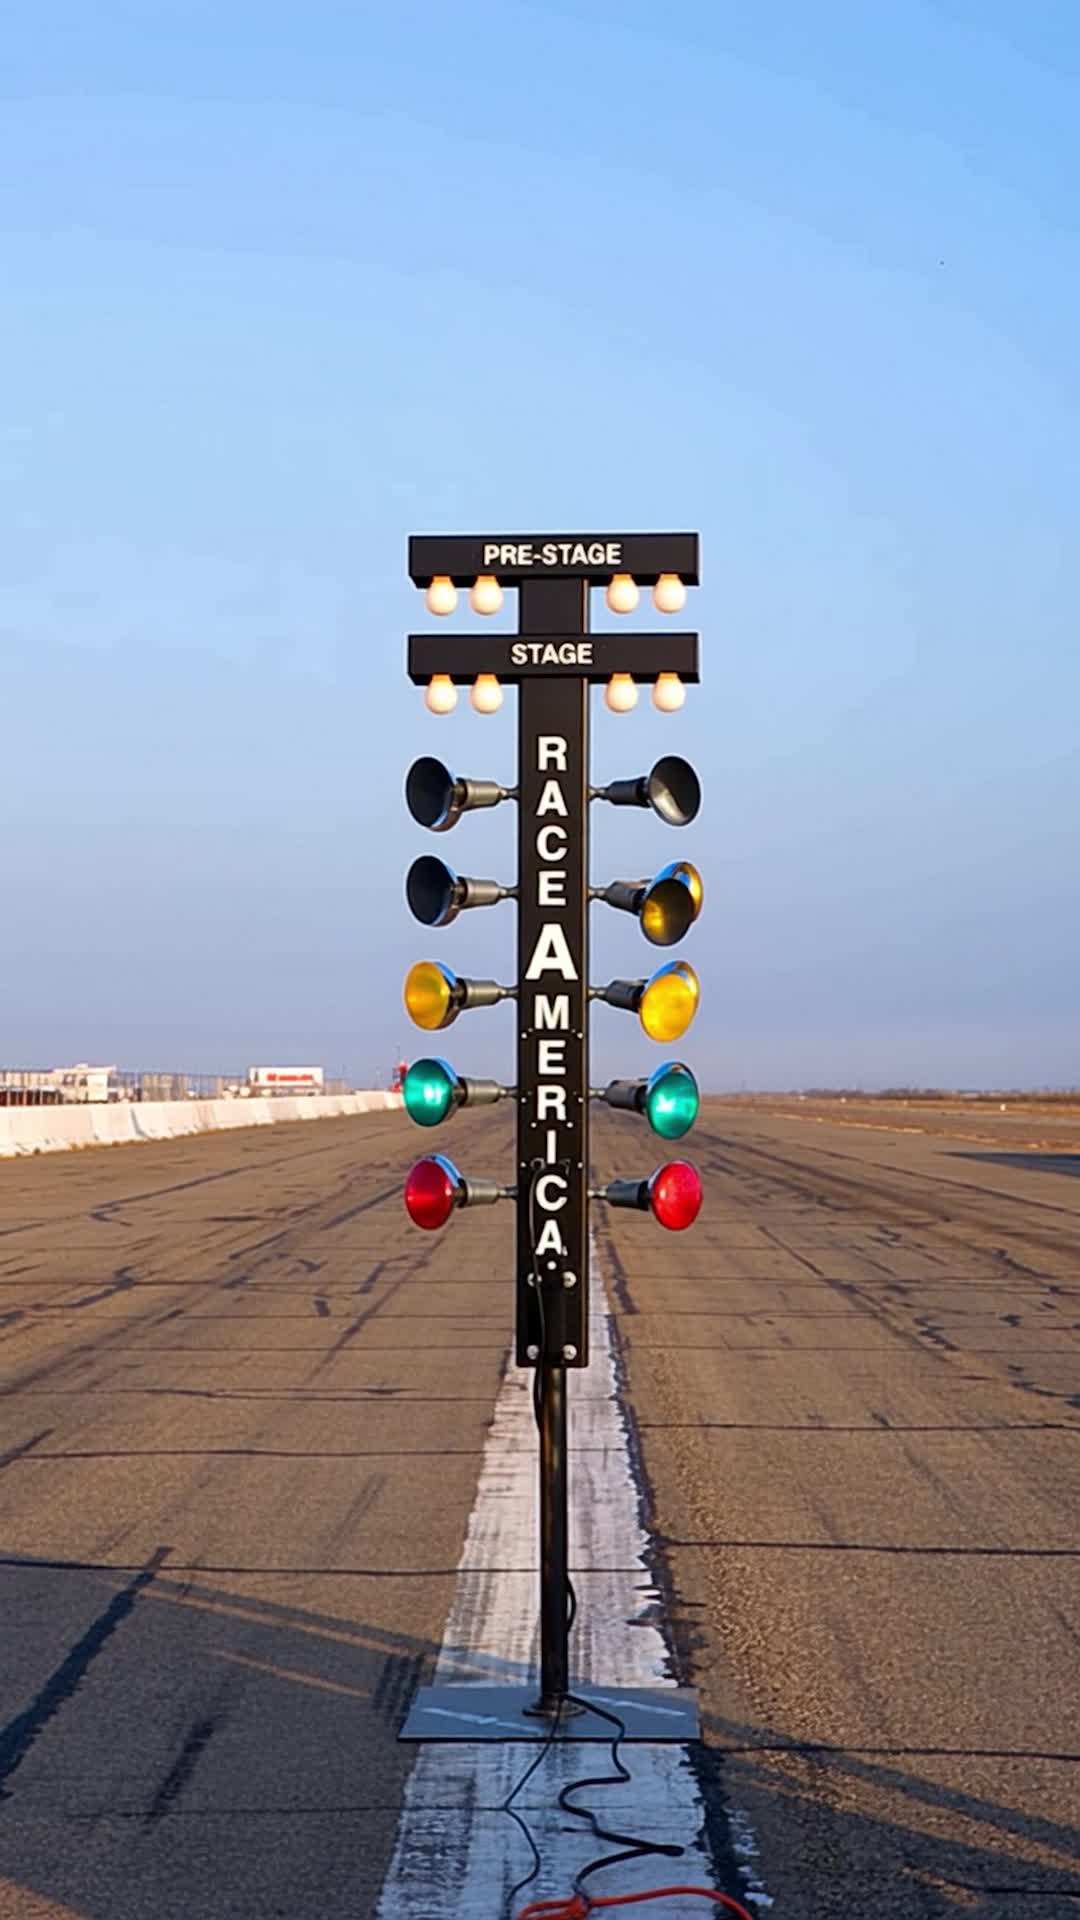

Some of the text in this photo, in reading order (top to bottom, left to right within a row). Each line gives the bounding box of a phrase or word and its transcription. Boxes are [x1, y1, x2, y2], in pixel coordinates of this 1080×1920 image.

[483, 543, 622, 565] PRE-STAGE
[511, 643, 593, 665] STAGE
[525, 735, 578, 1257] RACE AMERICA
